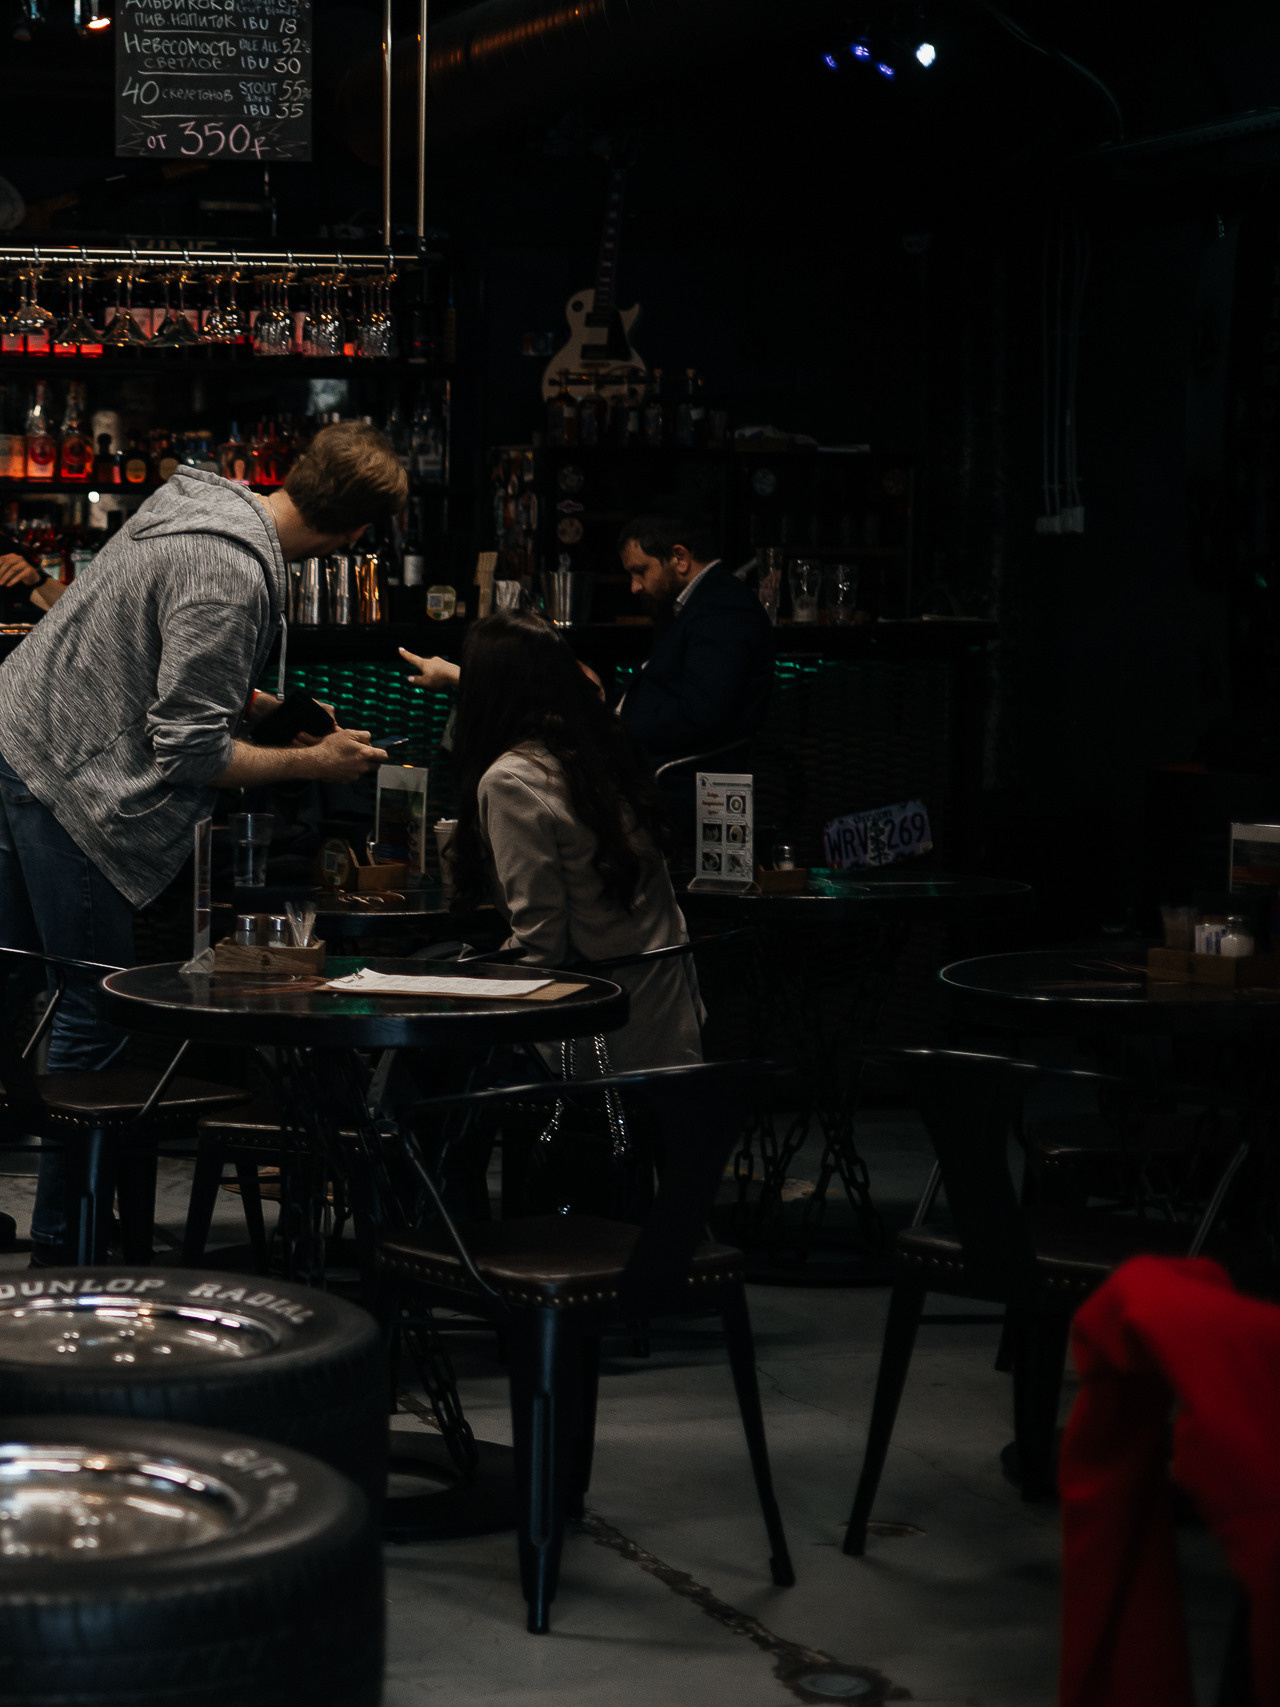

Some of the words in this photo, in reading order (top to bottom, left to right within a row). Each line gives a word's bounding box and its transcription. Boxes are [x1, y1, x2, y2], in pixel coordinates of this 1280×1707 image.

[279, 17, 297, 35] 18
[123, 31, 237, 57] Невесомость
[144, 56, 223, 70] светлое
[241, 55, 269, 70] IBU
[122, 76, 159, 104] 40
[243, 104, 270, 116] IBU
[275, 102, 305, 119] 35
[147, 134, 167, 150] от
[825, 823, 868, 860] WRV
[884, 813, 925, 850] 269
[188, 1281, 315, 1324] RADIAL
